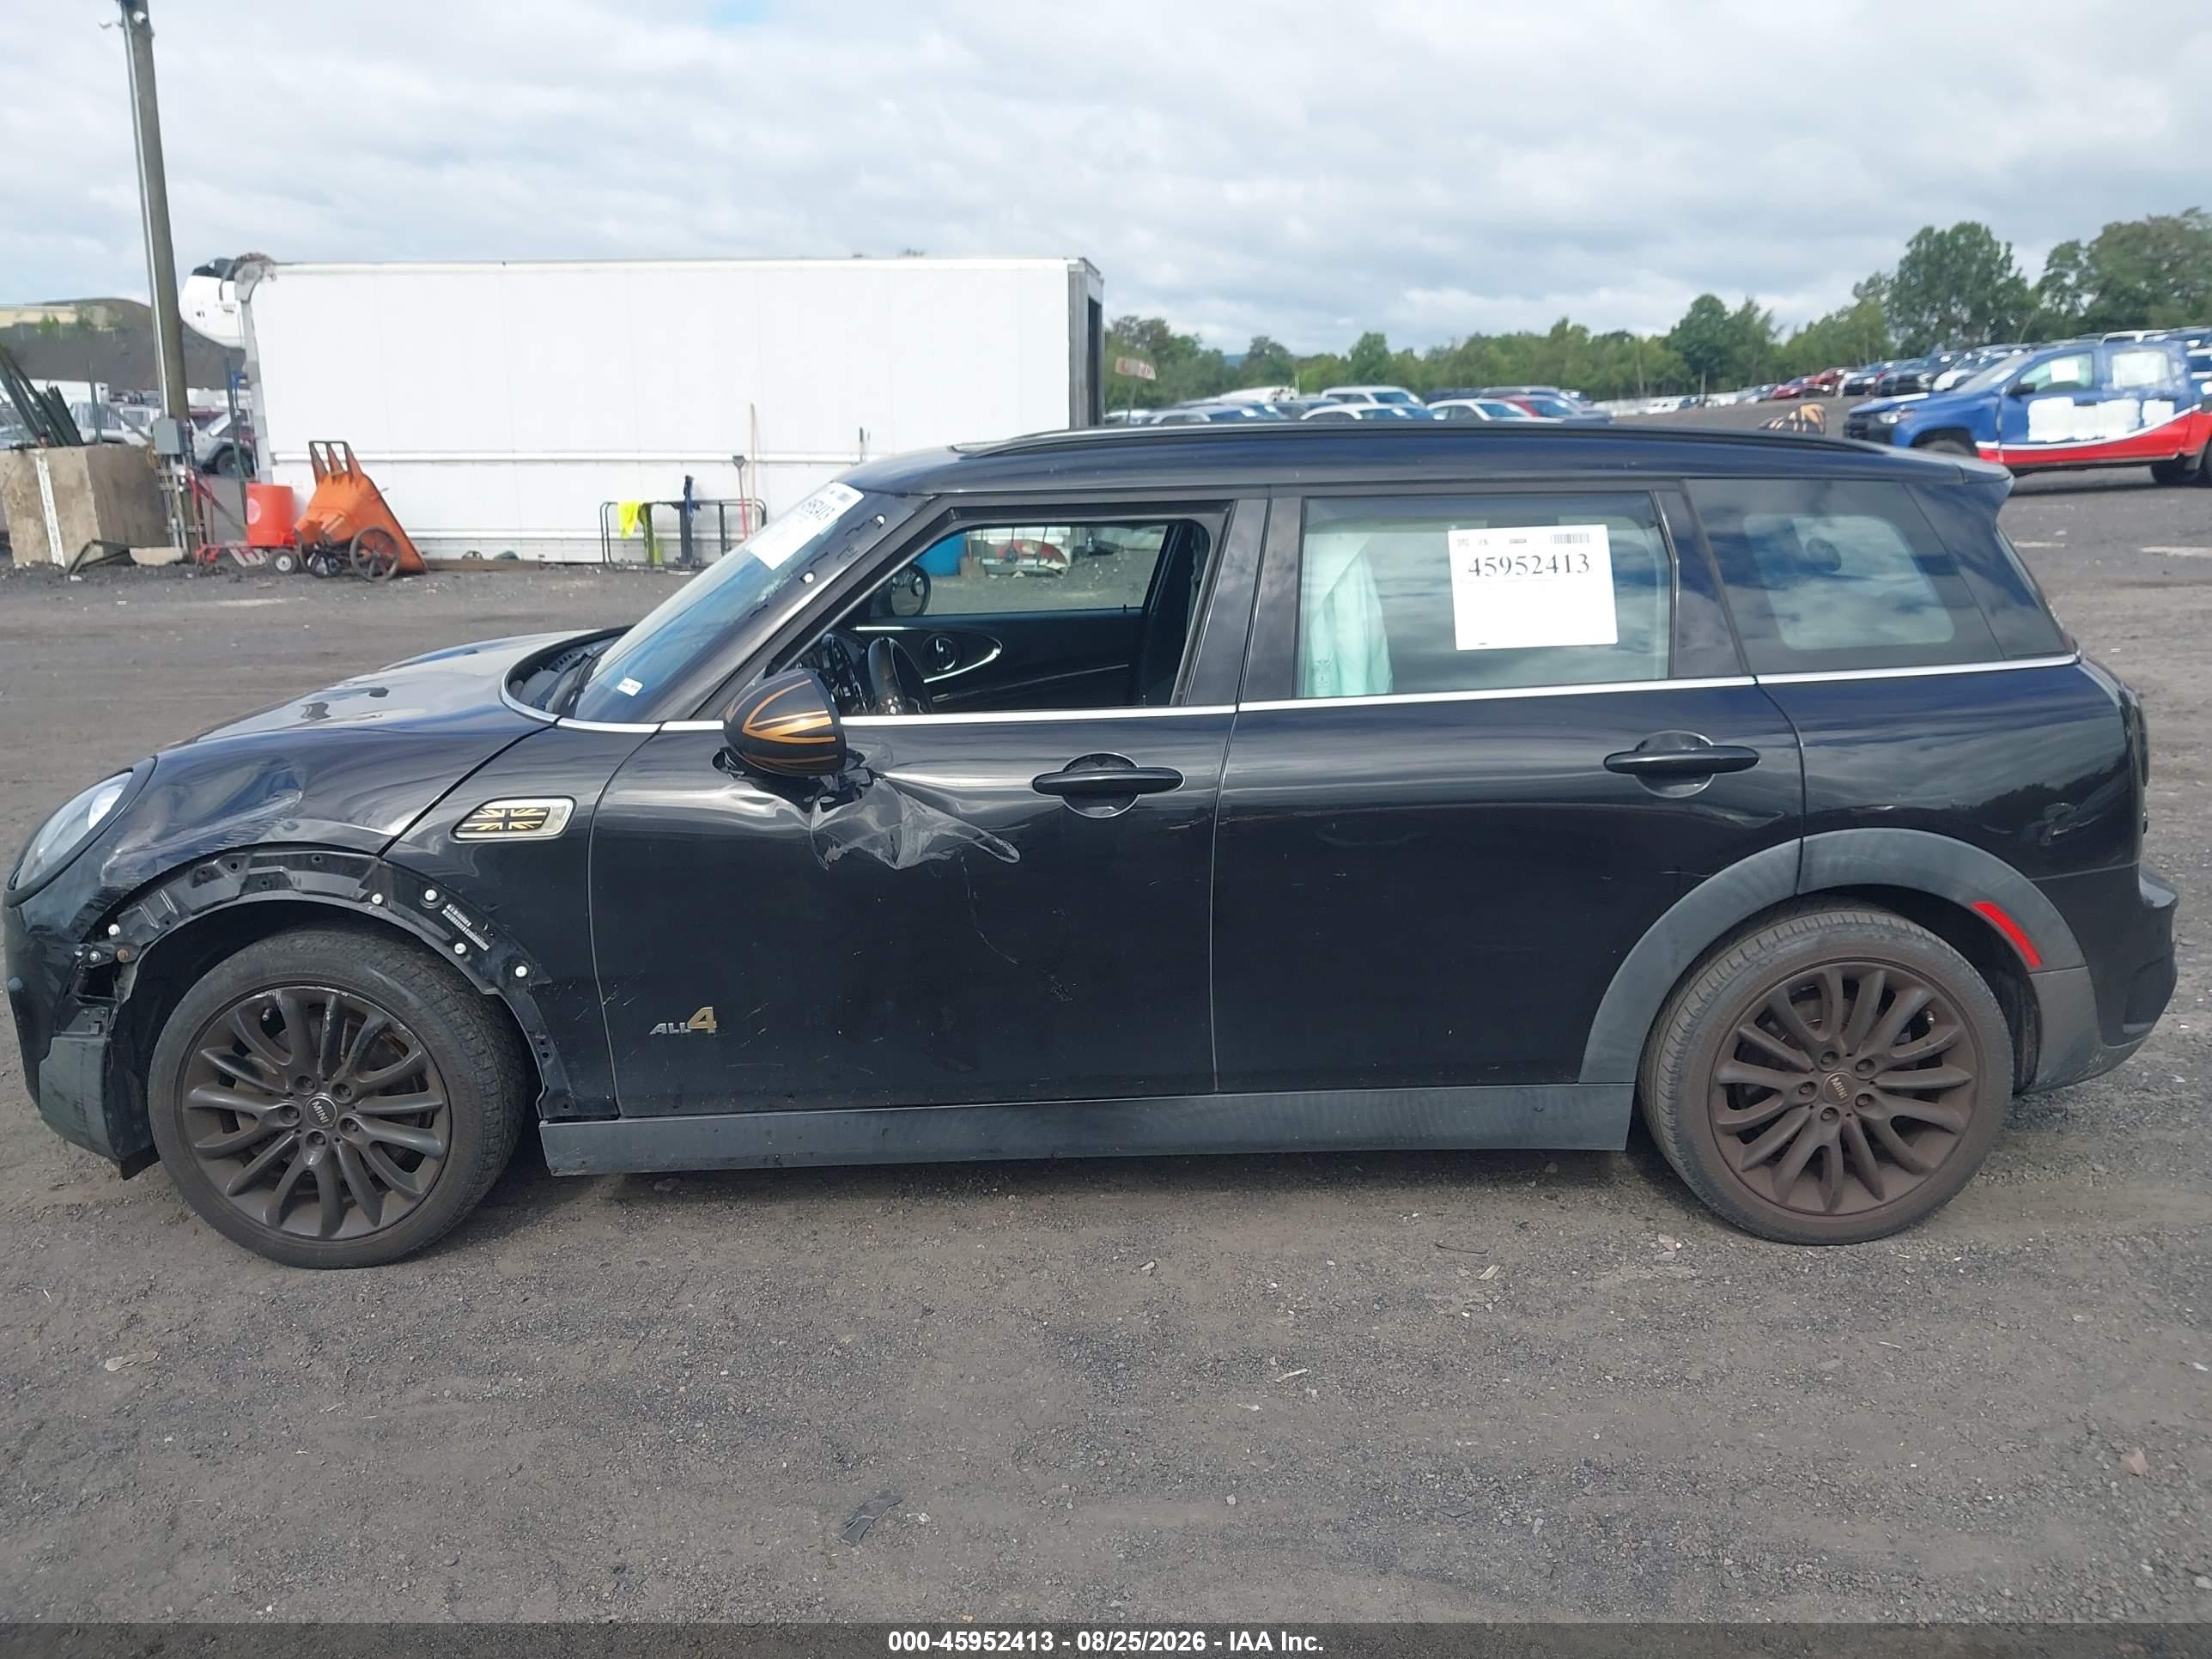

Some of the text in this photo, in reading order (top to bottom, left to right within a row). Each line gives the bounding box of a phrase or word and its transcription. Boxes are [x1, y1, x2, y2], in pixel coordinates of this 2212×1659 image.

[1468, 553, 1590, 577] 45952413
[649, 1006, 717, 1035] ALL4
[1830, 1077, 1849, 1099] MINI
[312, 1100, 331, 1124] MINI
